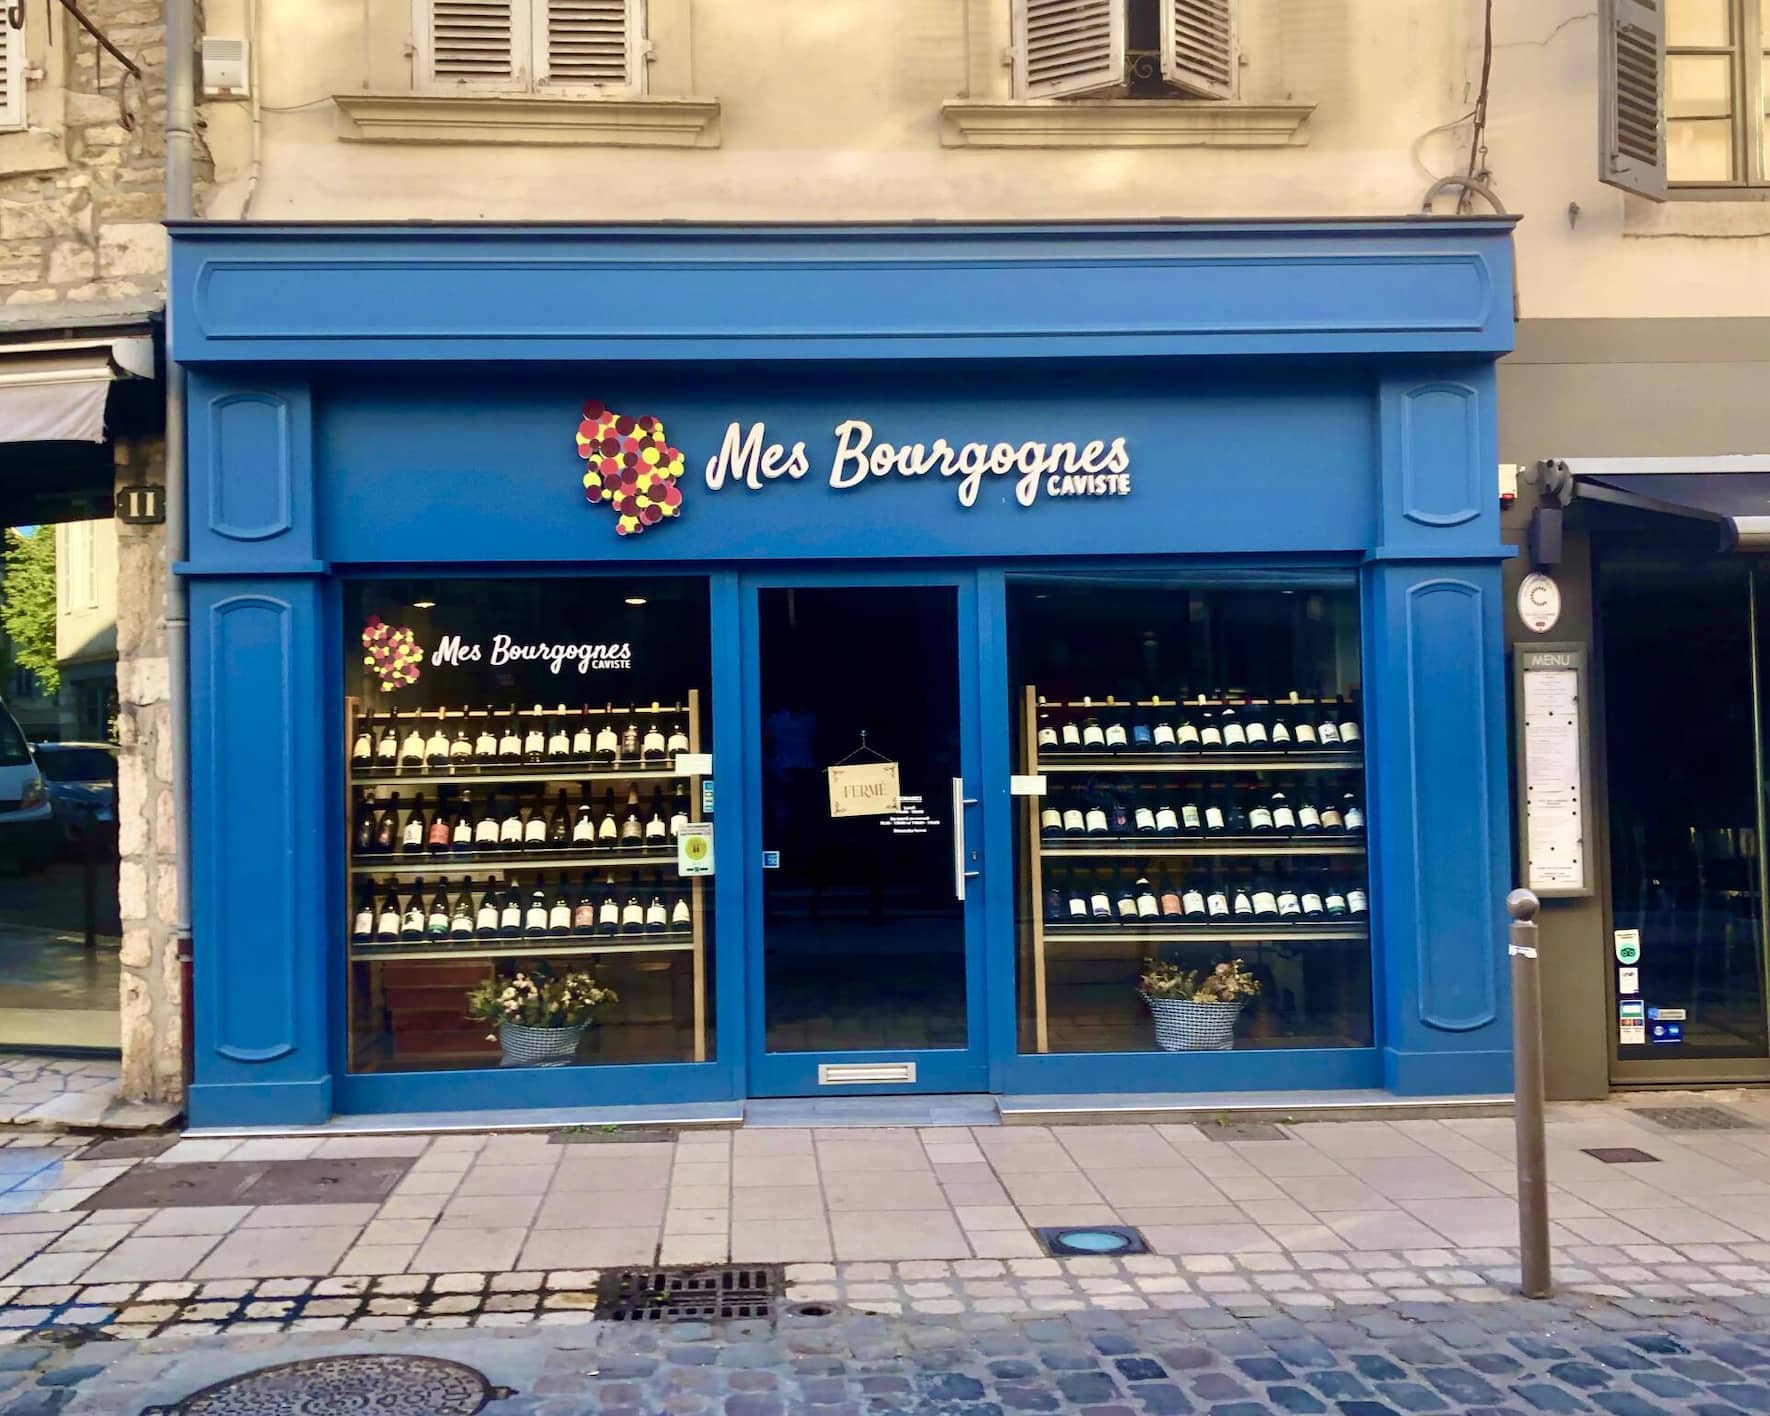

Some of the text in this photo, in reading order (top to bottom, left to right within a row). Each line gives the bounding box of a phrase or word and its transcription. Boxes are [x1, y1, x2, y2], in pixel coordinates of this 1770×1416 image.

[705, 419, 1131, 508] Mes Bourgognes
[1046, 473, 1132, 497] CAVISTE
[128, 491, 156, 518] 11
[431, 634, 632, 674] Mes Bourgognes
[591, 659, 632, 669] CAVISTE
[1531, 654, 1571, 666] MENU
